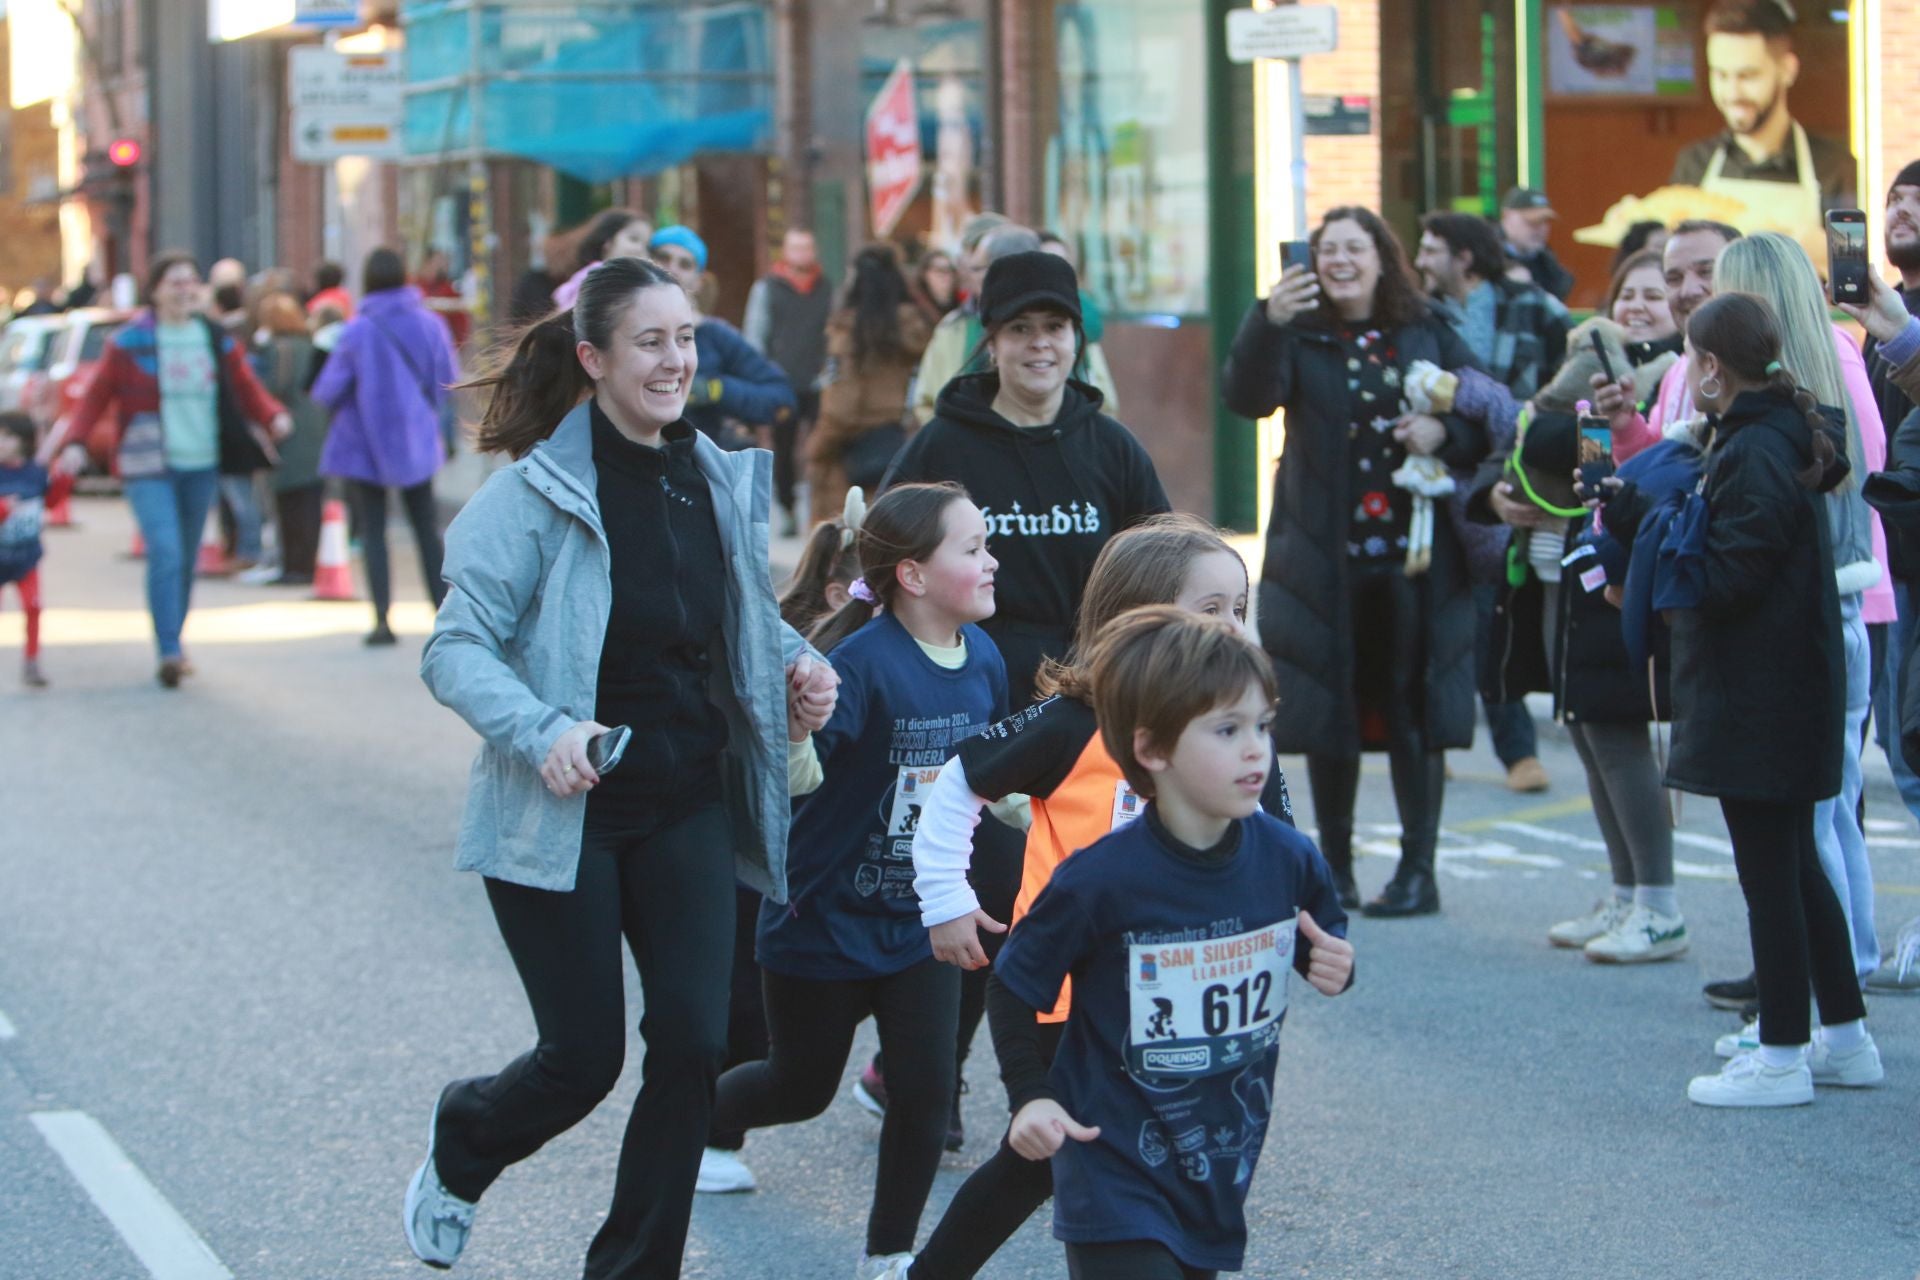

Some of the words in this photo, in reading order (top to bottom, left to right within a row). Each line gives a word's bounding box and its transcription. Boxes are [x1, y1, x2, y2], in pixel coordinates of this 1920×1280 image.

[894, 719, 905, 731] 31
[908, 715, 951, 731] diciembre
[951, 712, 970, 727] 2024
[889, 749, 945, 767] LLANERA
[1210, 917, 1244, 937] 2024
[1160, 947, 1195, 968] SAN
[1203, 930, 1275, 963] SILVESTRE
[1192, 957, 1253, 981] LLANERA
[1202, 970, 1272, 1037] 612
[1147, 1050, 1206, 1065] OQUENDO
